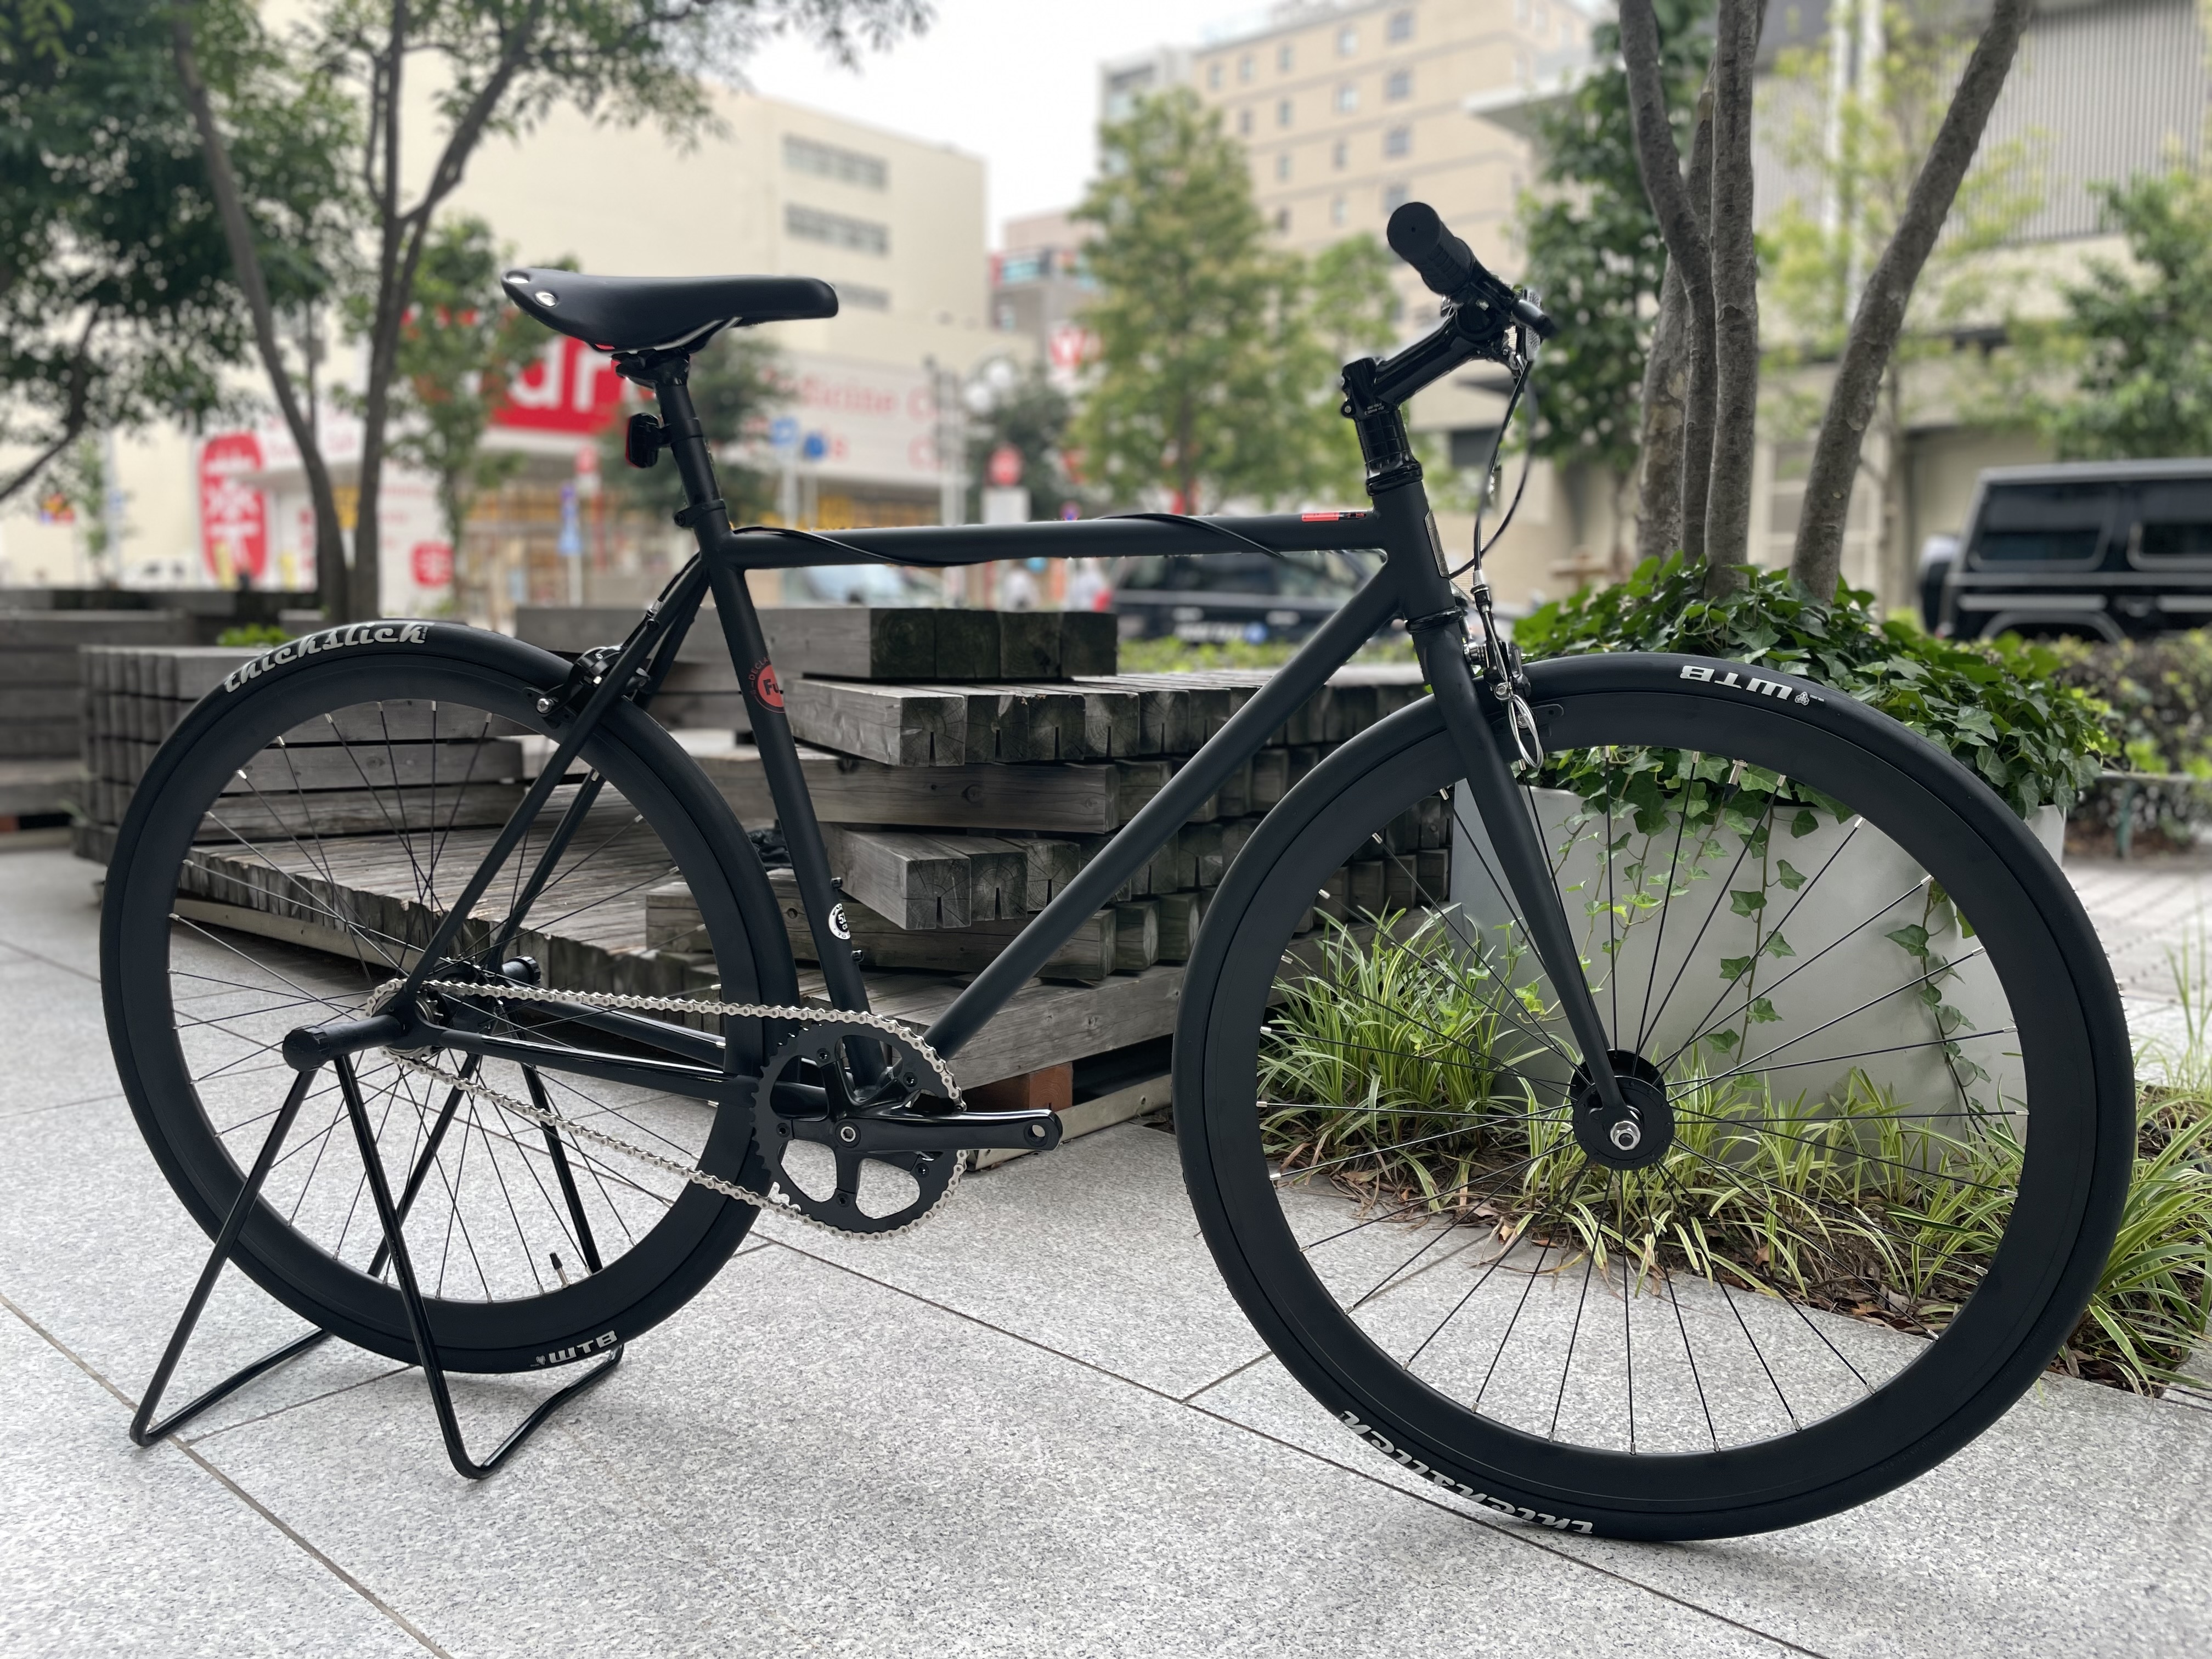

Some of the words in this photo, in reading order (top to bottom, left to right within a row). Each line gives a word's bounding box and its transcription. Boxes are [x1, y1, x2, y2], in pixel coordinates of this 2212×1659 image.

[224, 622, 435, 693] thickslick
[1679, 665, 1793, 701] WTB
[549, 1330, 618, 1364] WTB
